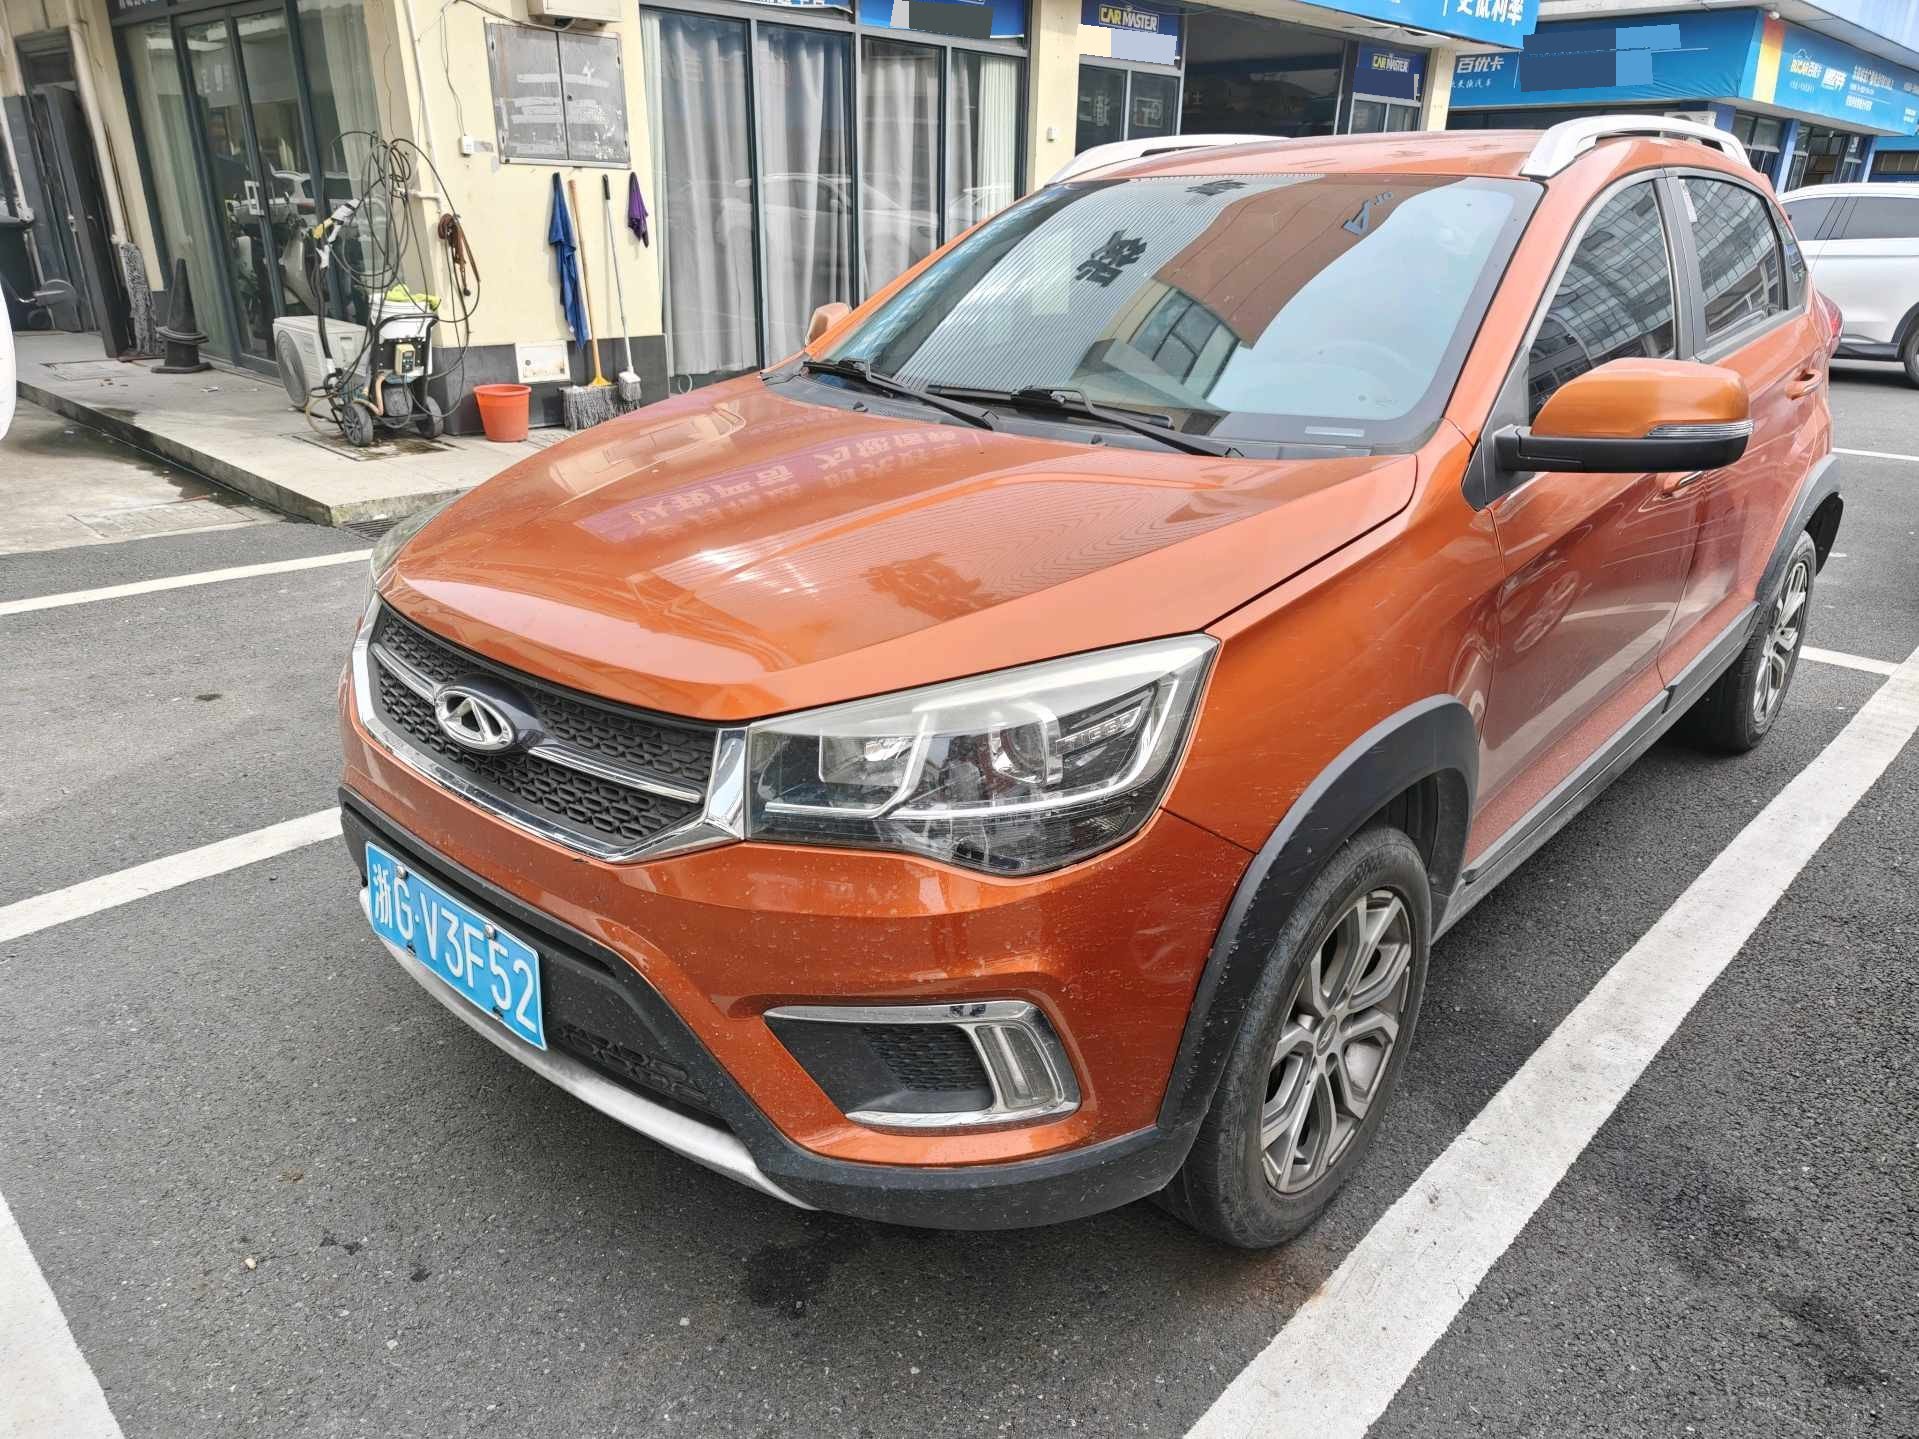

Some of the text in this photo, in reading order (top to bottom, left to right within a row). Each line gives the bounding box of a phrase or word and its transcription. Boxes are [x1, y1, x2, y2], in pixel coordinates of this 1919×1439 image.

[1100, 7, 1158, 31] CAR MASTER
[1372, 55, 1409, 73] CAR MASTER
[1456, 55, 1504, 73] 百优卡
